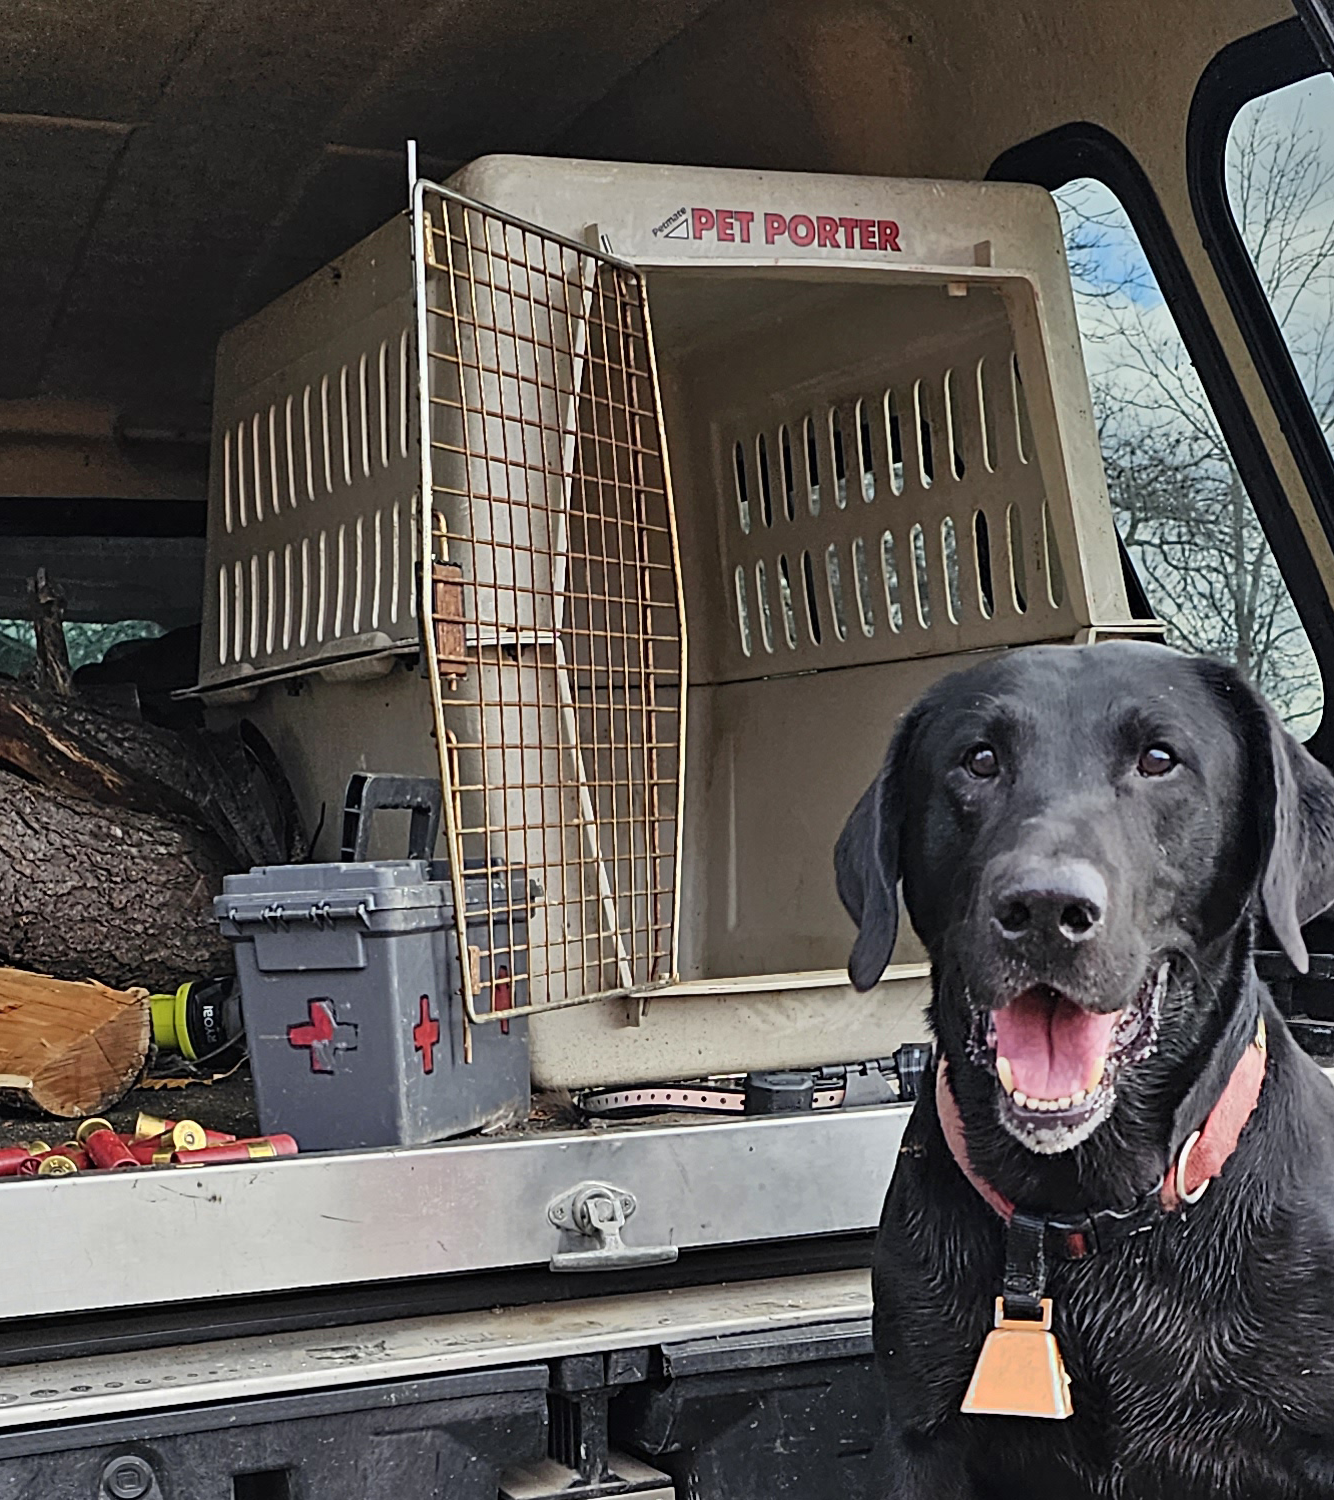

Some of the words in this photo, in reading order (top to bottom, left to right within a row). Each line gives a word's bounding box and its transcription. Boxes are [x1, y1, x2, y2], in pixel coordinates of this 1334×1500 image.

[652, 207, 686, 237] Petmate
[691, 207, 754, 243] PET
[764, 212, 902, 252] PORTER
[203, 1005, 217, 1043] RYOBI
